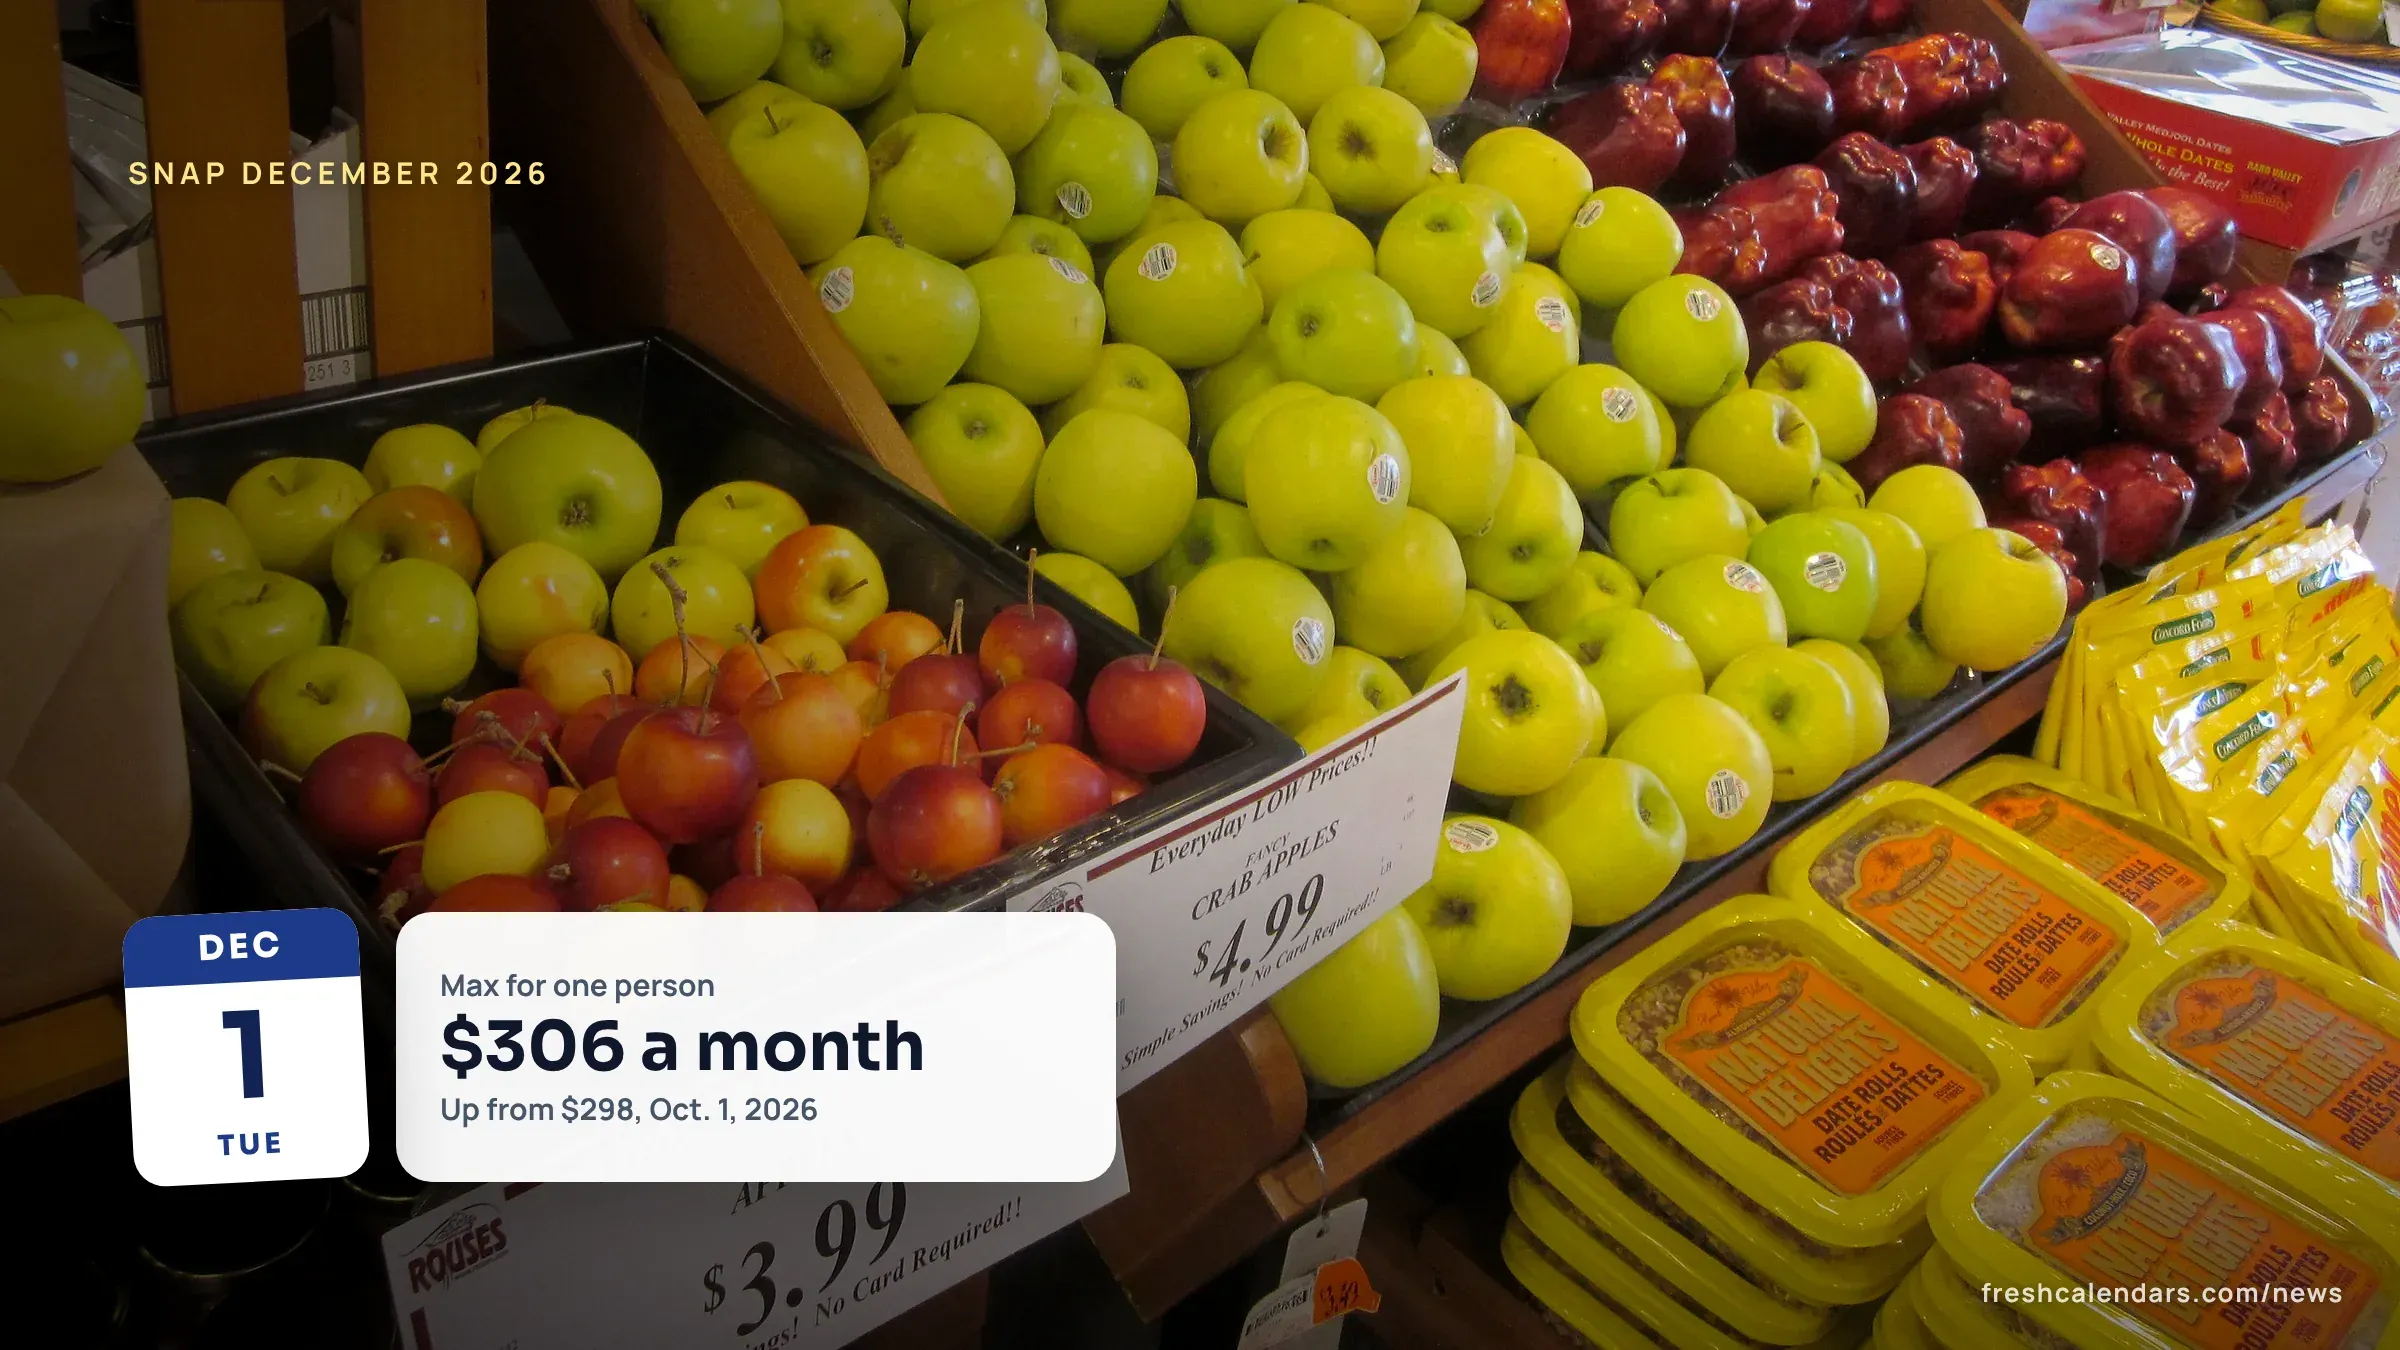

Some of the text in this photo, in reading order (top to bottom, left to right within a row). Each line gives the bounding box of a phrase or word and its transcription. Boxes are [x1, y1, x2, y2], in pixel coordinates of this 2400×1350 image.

[2180, 148, 2235, 175] DATES
[2193, 171, 2231, 192] Best!
[2196, 136, 2233, 155] DATES
[1149, 735, 1378, 875] Everyday LOW Prices!!
[1191, 817, 1341, 922] CRAB APPLES
[1244, 831, 1291, 869] FANCY
[1191, 872, 1326, 989] $4.99
[1886, 856, 2004, 945] NATURAL
[1926, 876, 2042, 974] DELIGHTS
[1983, 940, 2022, 976] DATE
[2011, 911, 2054, 949] ROLLS
[2034, 912, 2083, 956] DATTES
[1120, 886, 1381, 1072] Simple Savings! No Card Required!!
[1706, 992, 1861, 1095] NATURAL
[1749, 1019, 1900, 1128] DELIGHTS
[2210, 997, 2339, 1088] NATURAL
[1811, 1061, 1909, 1135] DATE ROLLS
[1880, 1062, 1945, 1114] DATTES
[2328, 1088, 2372, 1123] DATE
[407, 1216, 508, 1294] ROUSES
[702, 1182, 907, 1337] $3.99
[813, 1296, 845, 1328] No
[852, 1258, 905, 1303] Card
[910, 1196, 1022, 1274] Required!!
